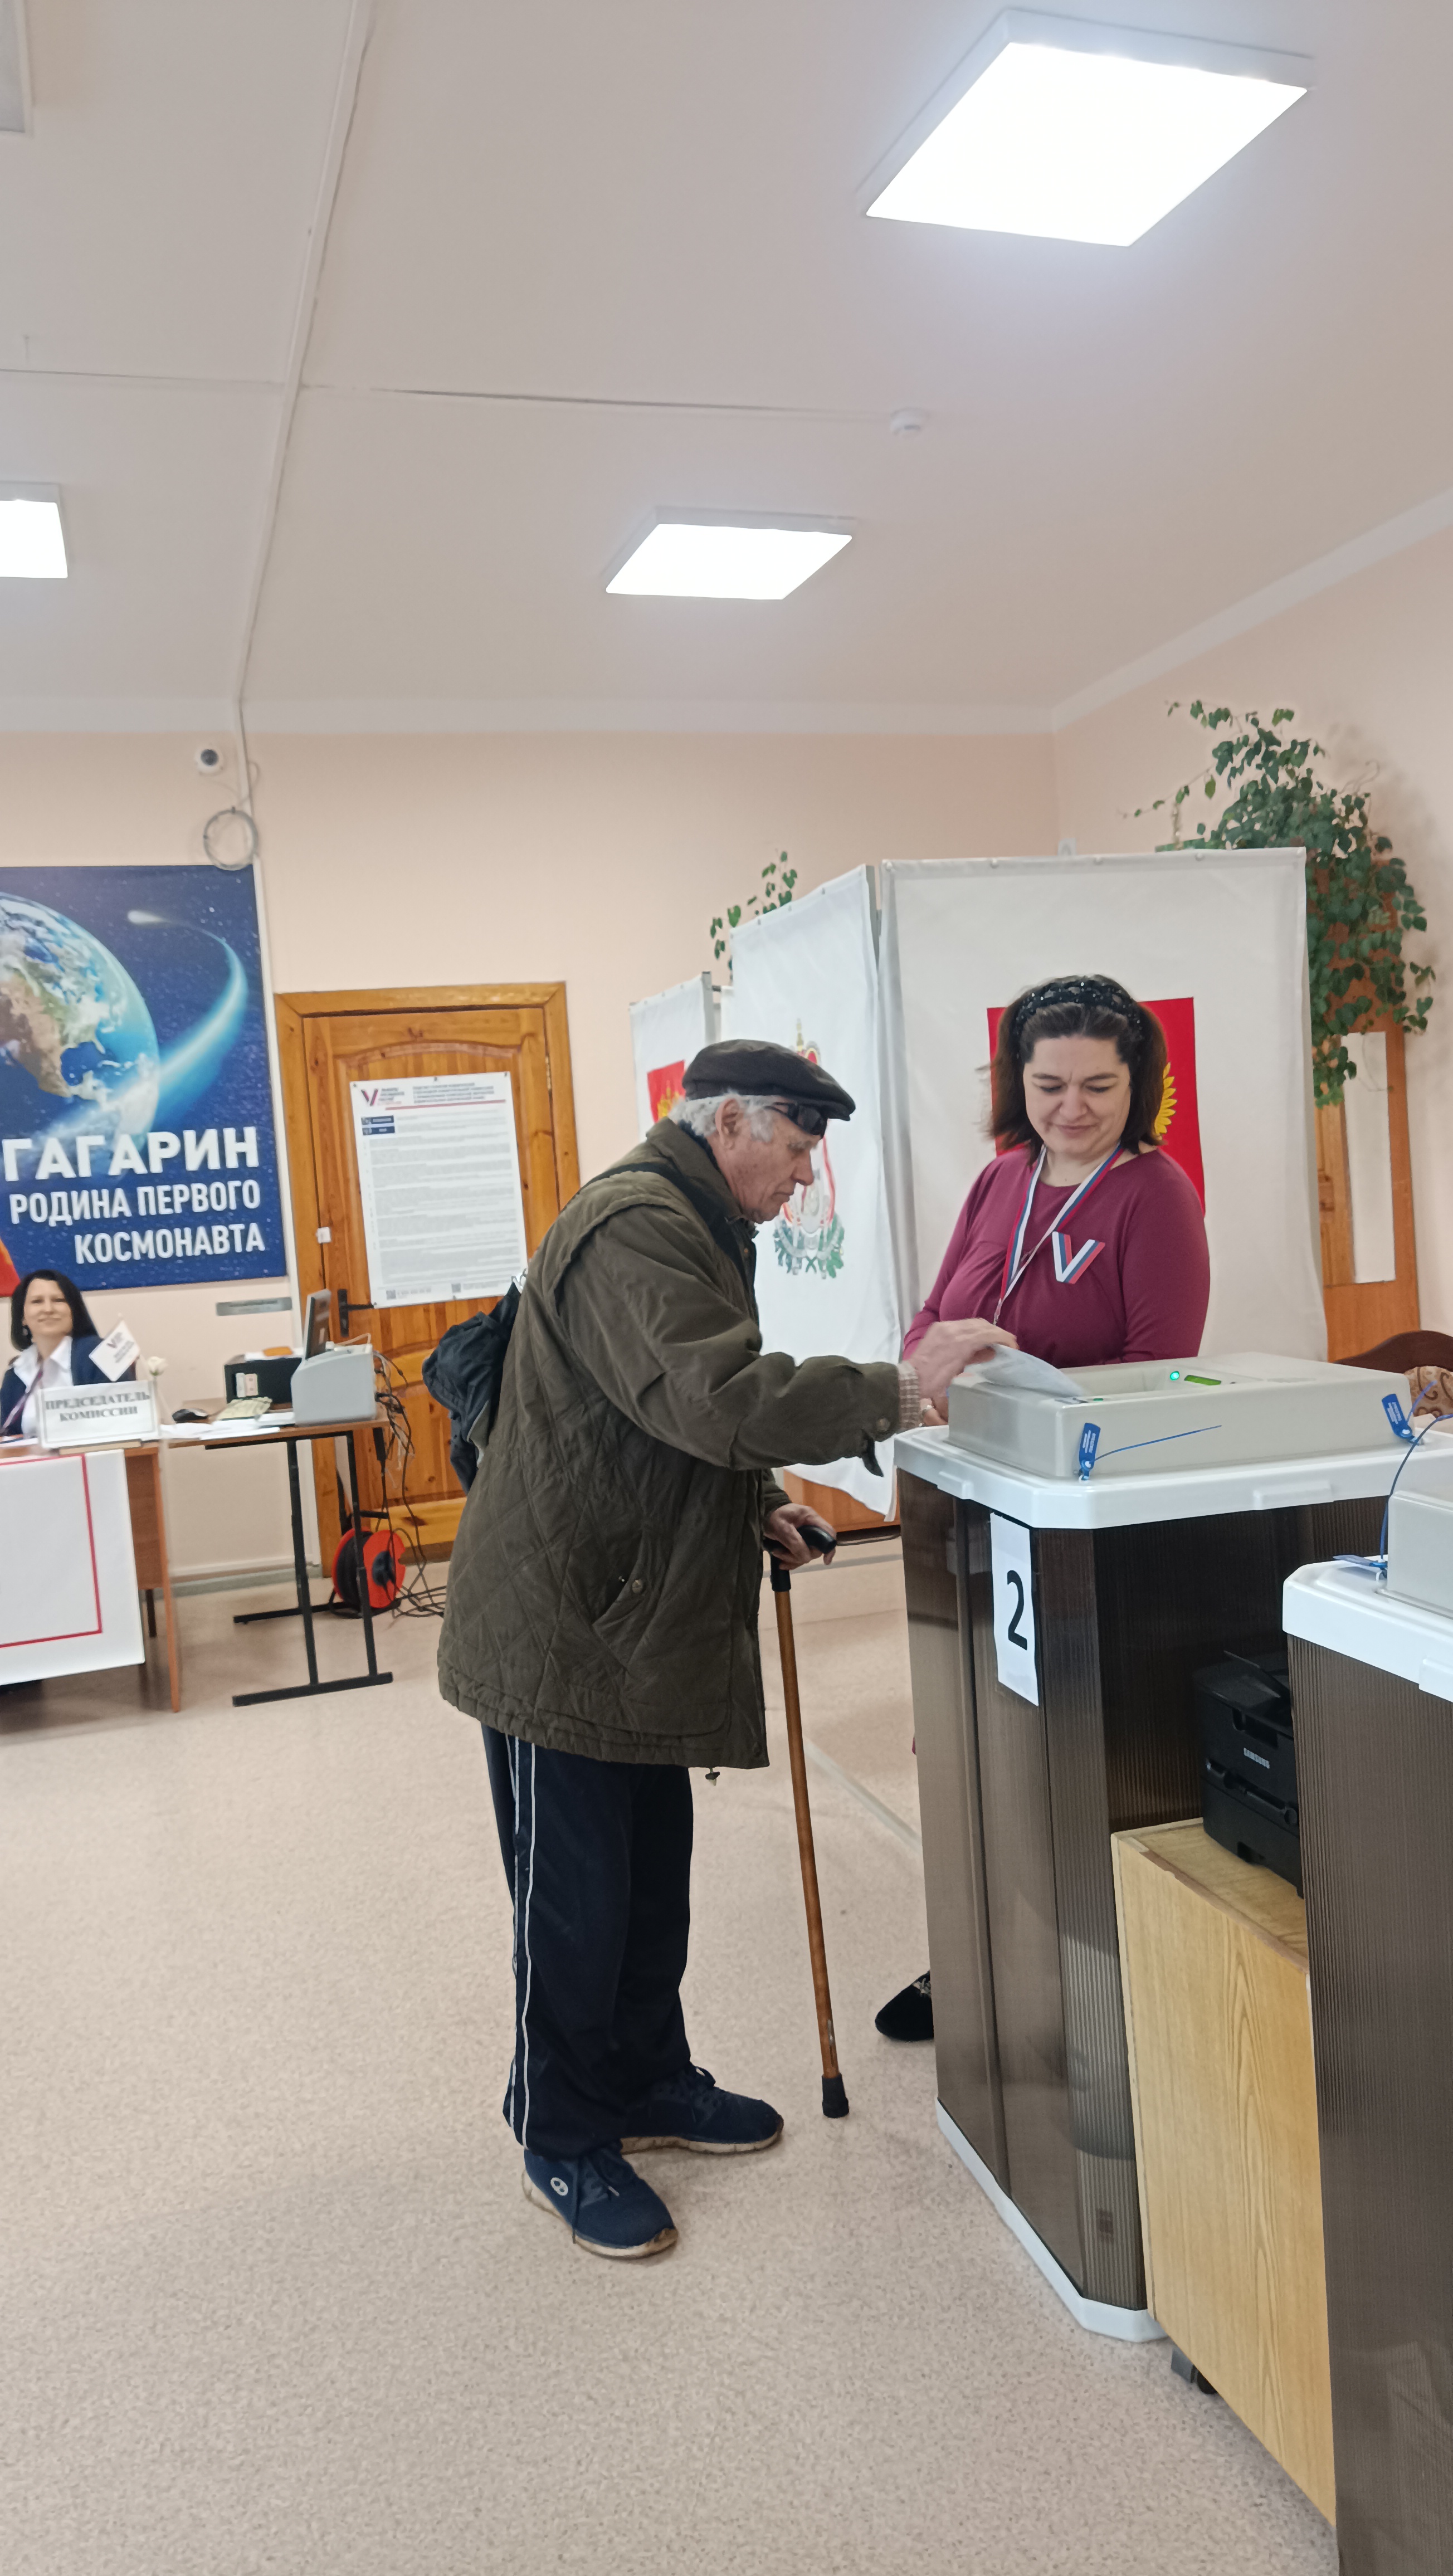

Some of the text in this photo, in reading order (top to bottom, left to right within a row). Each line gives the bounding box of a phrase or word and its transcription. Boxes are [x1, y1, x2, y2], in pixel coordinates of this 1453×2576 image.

[2, 1126, 259, 1182] ГАГАРИН
[9, 1179, 261, 1227] РОДИНА ПЕРВОГО
[74, 1222, 265, 1264] КОСМОНАВТА
[46, 1392, 150, 1410] ПРЕДСЕДАТЕЛЬ
[60, 1406, 138, 1422] КОМИССИИ
[1007, 1569, 1028, 1651] 2
